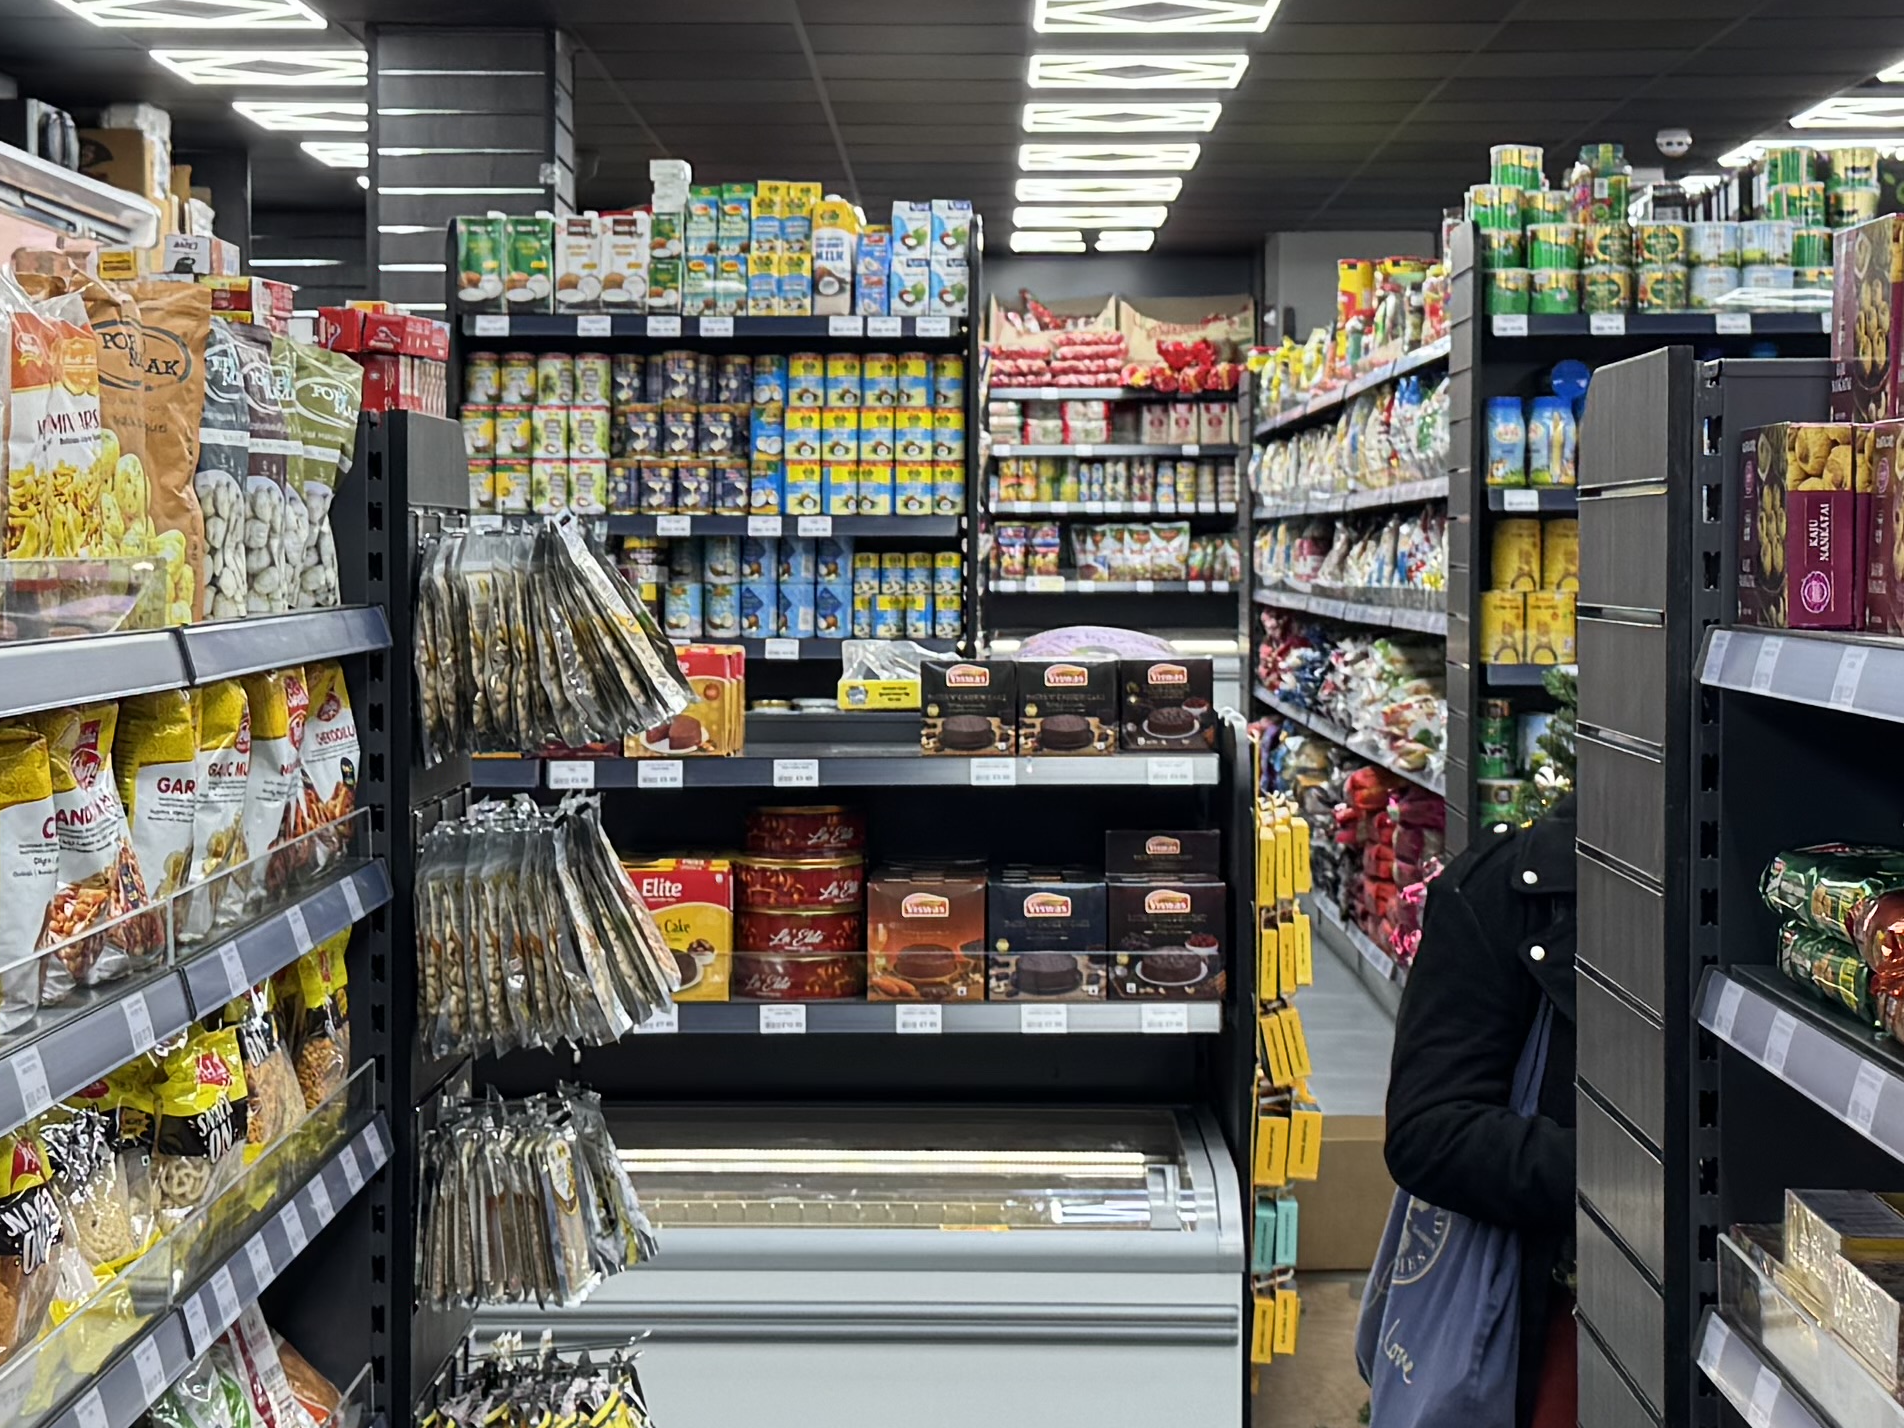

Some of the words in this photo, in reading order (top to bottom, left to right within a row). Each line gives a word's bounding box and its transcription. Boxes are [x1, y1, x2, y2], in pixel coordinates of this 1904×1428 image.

[1809, 521, 1819, 549] KAJU
[1820, 504, 1830, 561] NANKATAI
[643, 879, 682, 897] Elite
[665, 920, 690, 933] Cake
